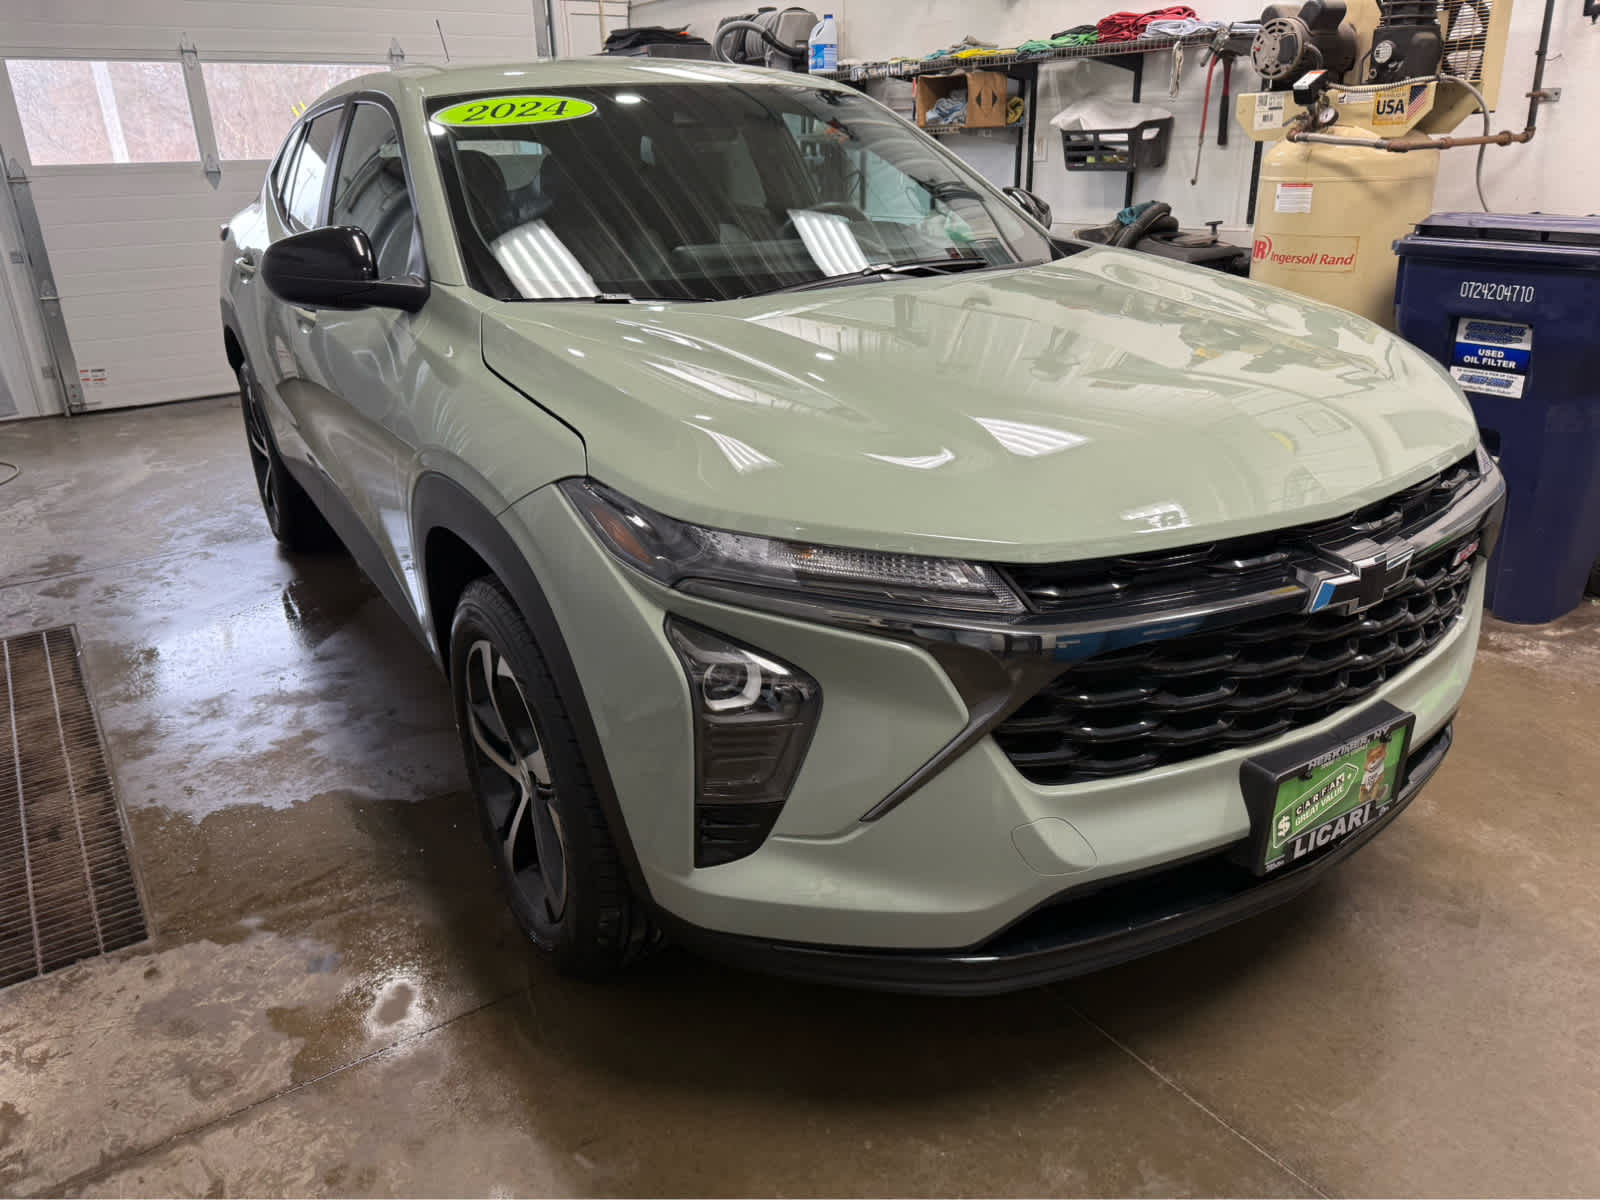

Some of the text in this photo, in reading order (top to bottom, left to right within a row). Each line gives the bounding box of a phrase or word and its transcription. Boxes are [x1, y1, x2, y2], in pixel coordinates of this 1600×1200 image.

[462, 101, 569, 122] 2024
[1376, 99, 1405, 115] USA
[1270, 252, 1355, 266] Ingersoll Rand
[1460, 281, 1535, 303] 0724204710
[1463, 355, 1517, 369] OIL FILTER
[1478, 348, 1505, 358] USED
[1295, 785, 1345, 827] GREAT VALUE
[1293, 803, 1371, 859] LICARI
